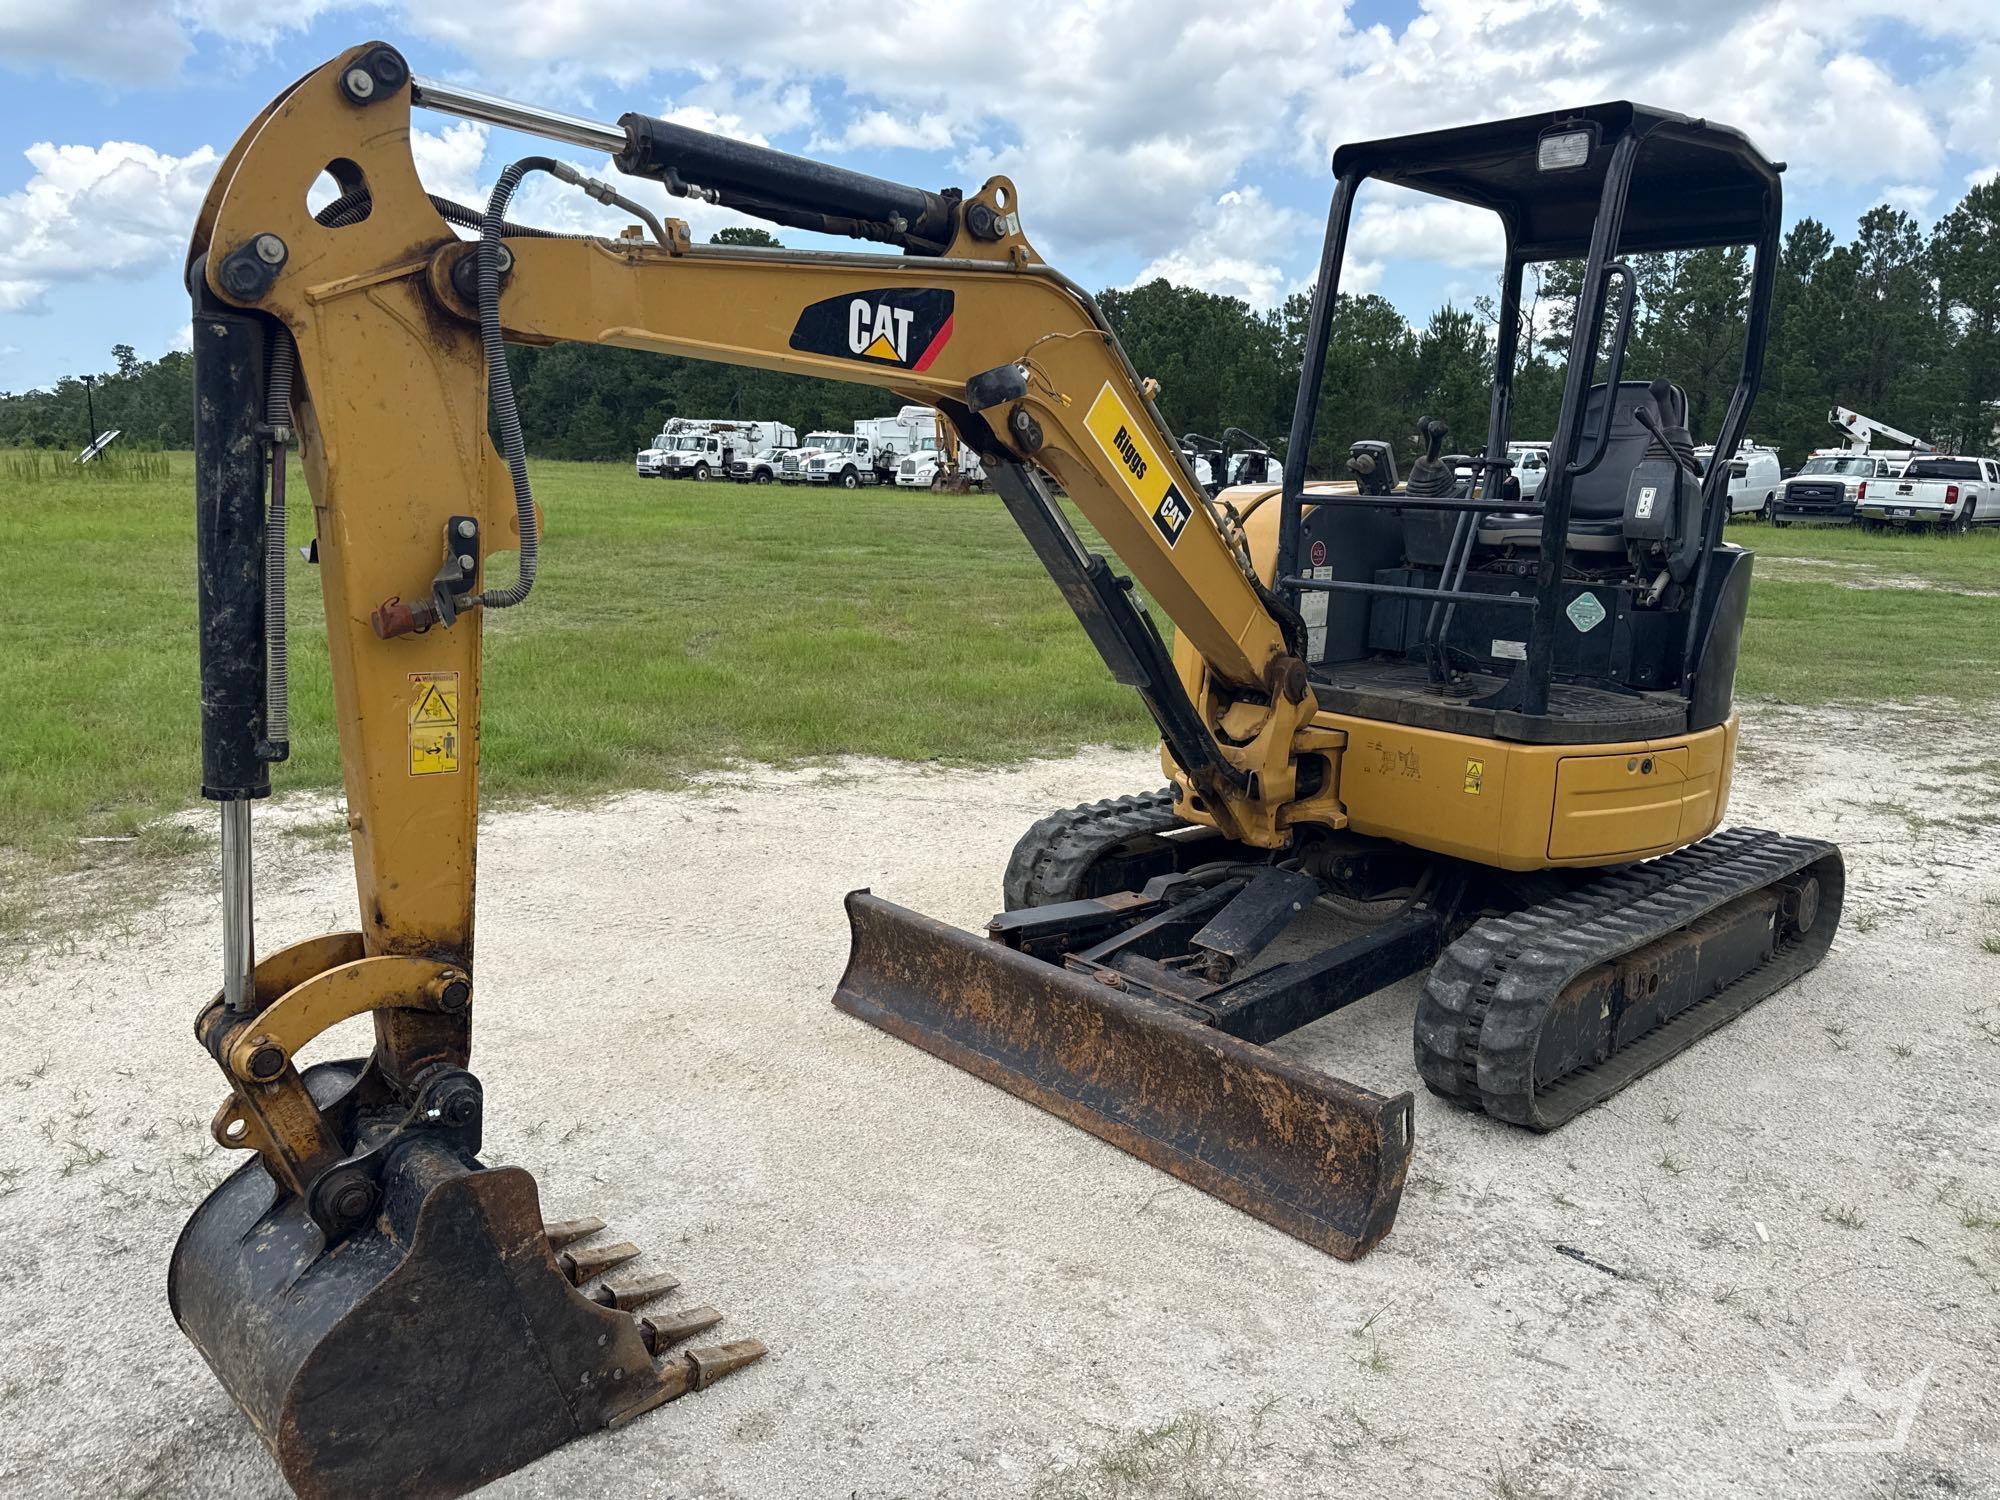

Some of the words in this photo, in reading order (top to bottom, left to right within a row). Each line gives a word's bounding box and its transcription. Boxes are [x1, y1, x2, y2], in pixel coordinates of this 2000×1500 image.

[849, 298, 914, 363] CAT
[1113, 425, 1147, 480] Riggs
[1160, 496, 1186, 533] CAT
